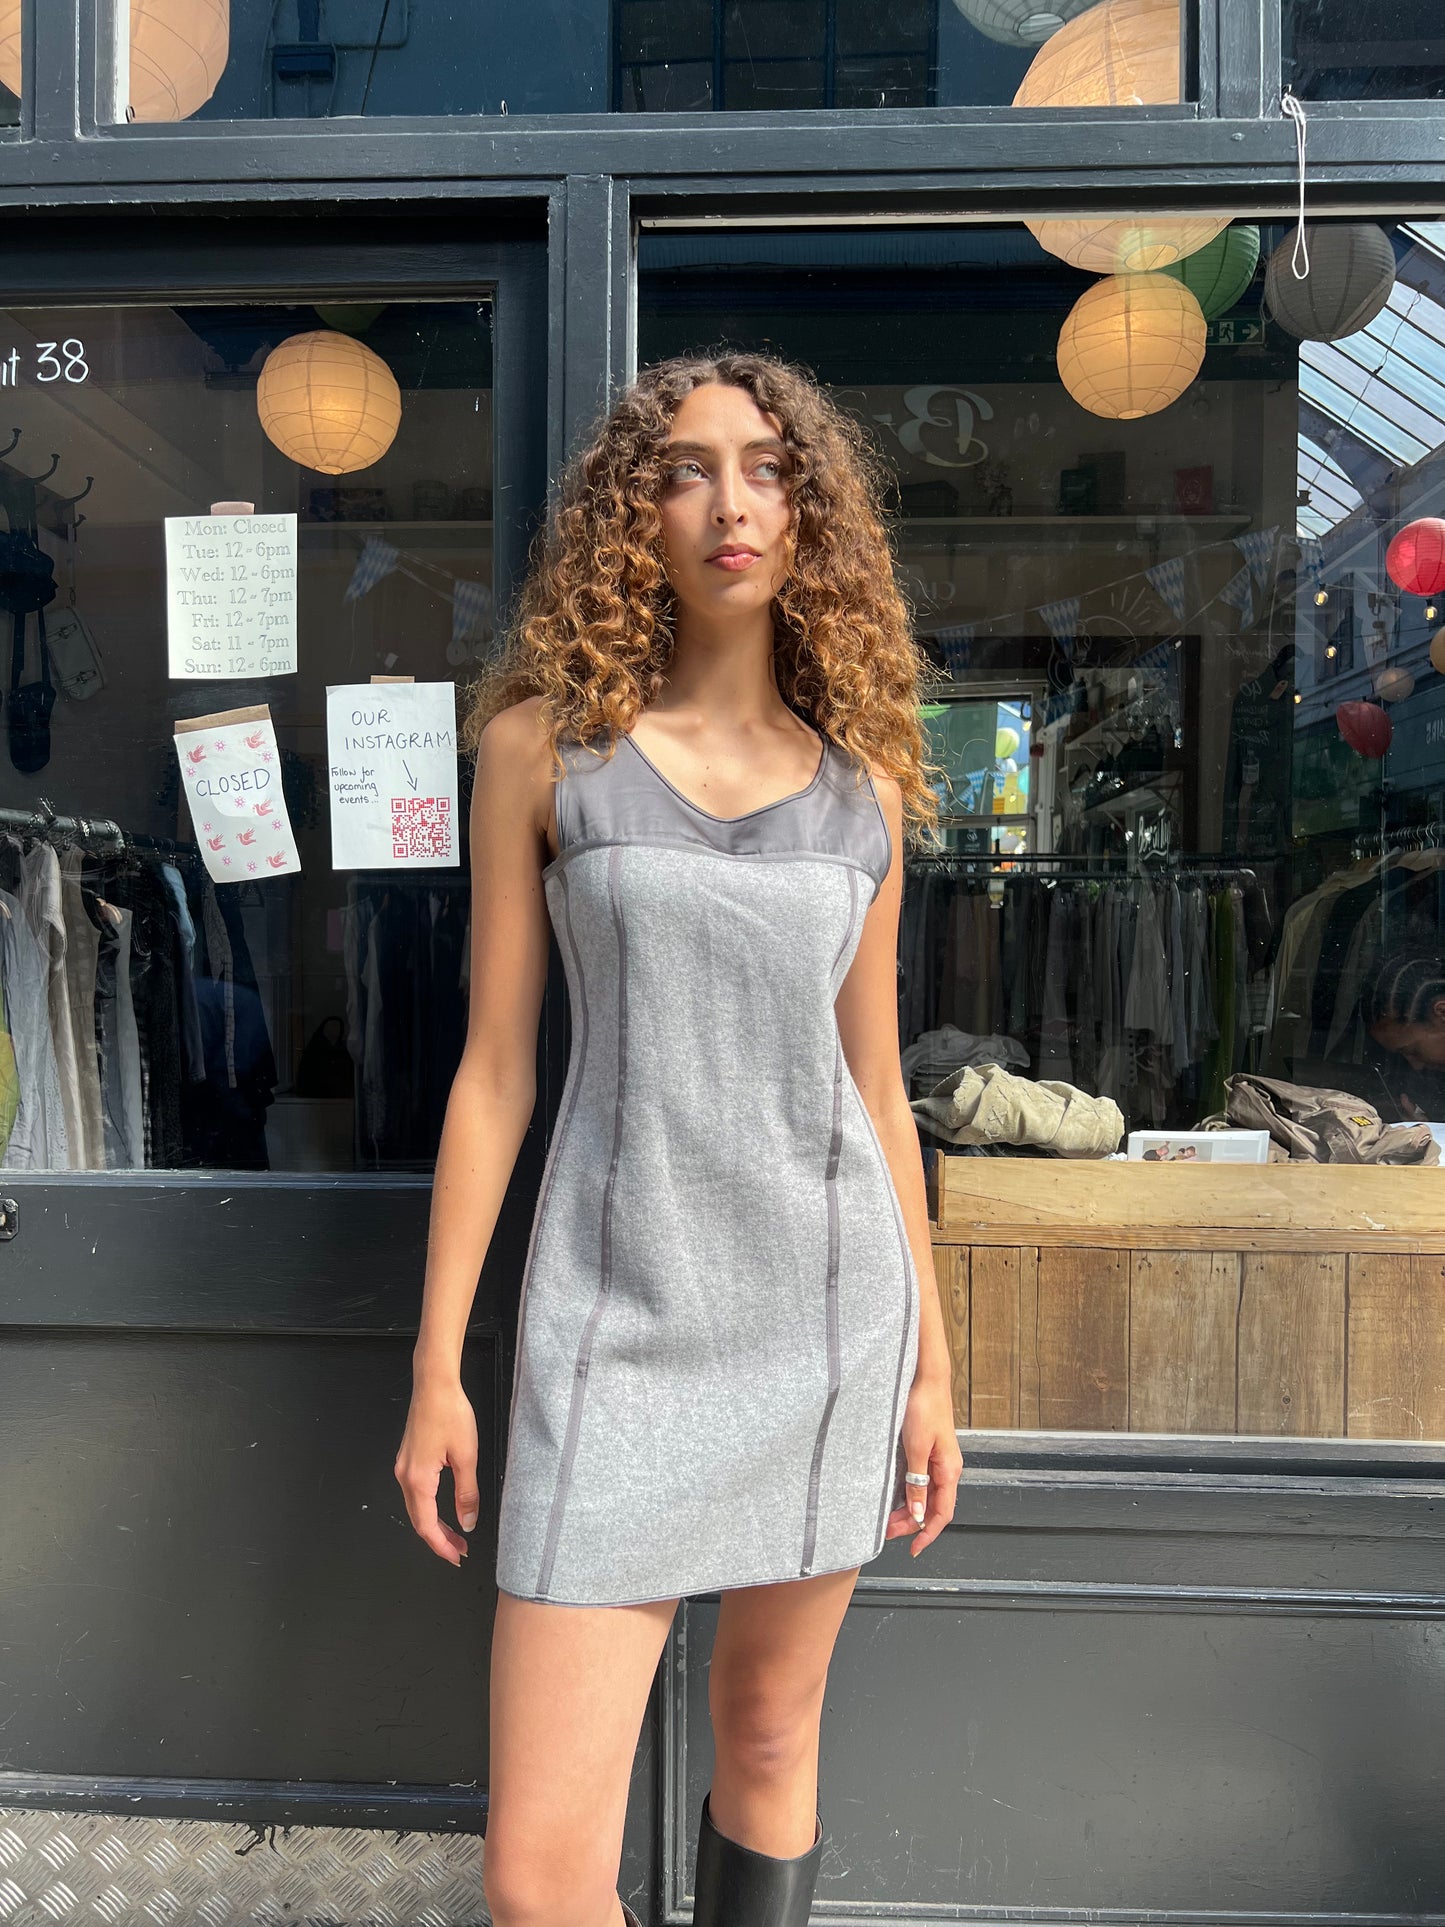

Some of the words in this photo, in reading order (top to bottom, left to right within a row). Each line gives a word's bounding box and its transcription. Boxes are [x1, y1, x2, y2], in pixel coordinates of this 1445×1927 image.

[36, 338, 89, 382] 38
[184, 520, 227, 536] Mon:
[233, 518, 287, 534] Closed
[182, 544, 219, 559] Tue:
[225, 541, 243, 558] 12
[256, 541, 291, 560] 6pm
[180, 566, 224, 582] Wed:
[231, 565, 247, 581] 12
[261, 564, 295, 583] 6pm
[177, 590, 217, 605] Thu:
[230, 587, 247, 604] 12
[261, 587, 293, 607] 7pm
[192, 613, 219, 628] Fri:
[226, 610, 243, 627] 12
[257, 611, 289, 630] 7pm
[192, 636, 221, 651] Sat:
[228, 635, 242, 650] 11
[258, 634, 290, 653] 7pm
[184, 659, 221, 674] Sun:
[228, 656, 246, 673] 12
[260, 656, 292, 675] 6pm
[351, 708, 391, 726] OUR
[345, 731, 452, 750] INSTAGRAM
[196, 768, 271, 797] CLOSED
[331, 766, 357, 777] Follow
[360, 766, 375, 783] for
[334, 782, 379, 797] upcoming
